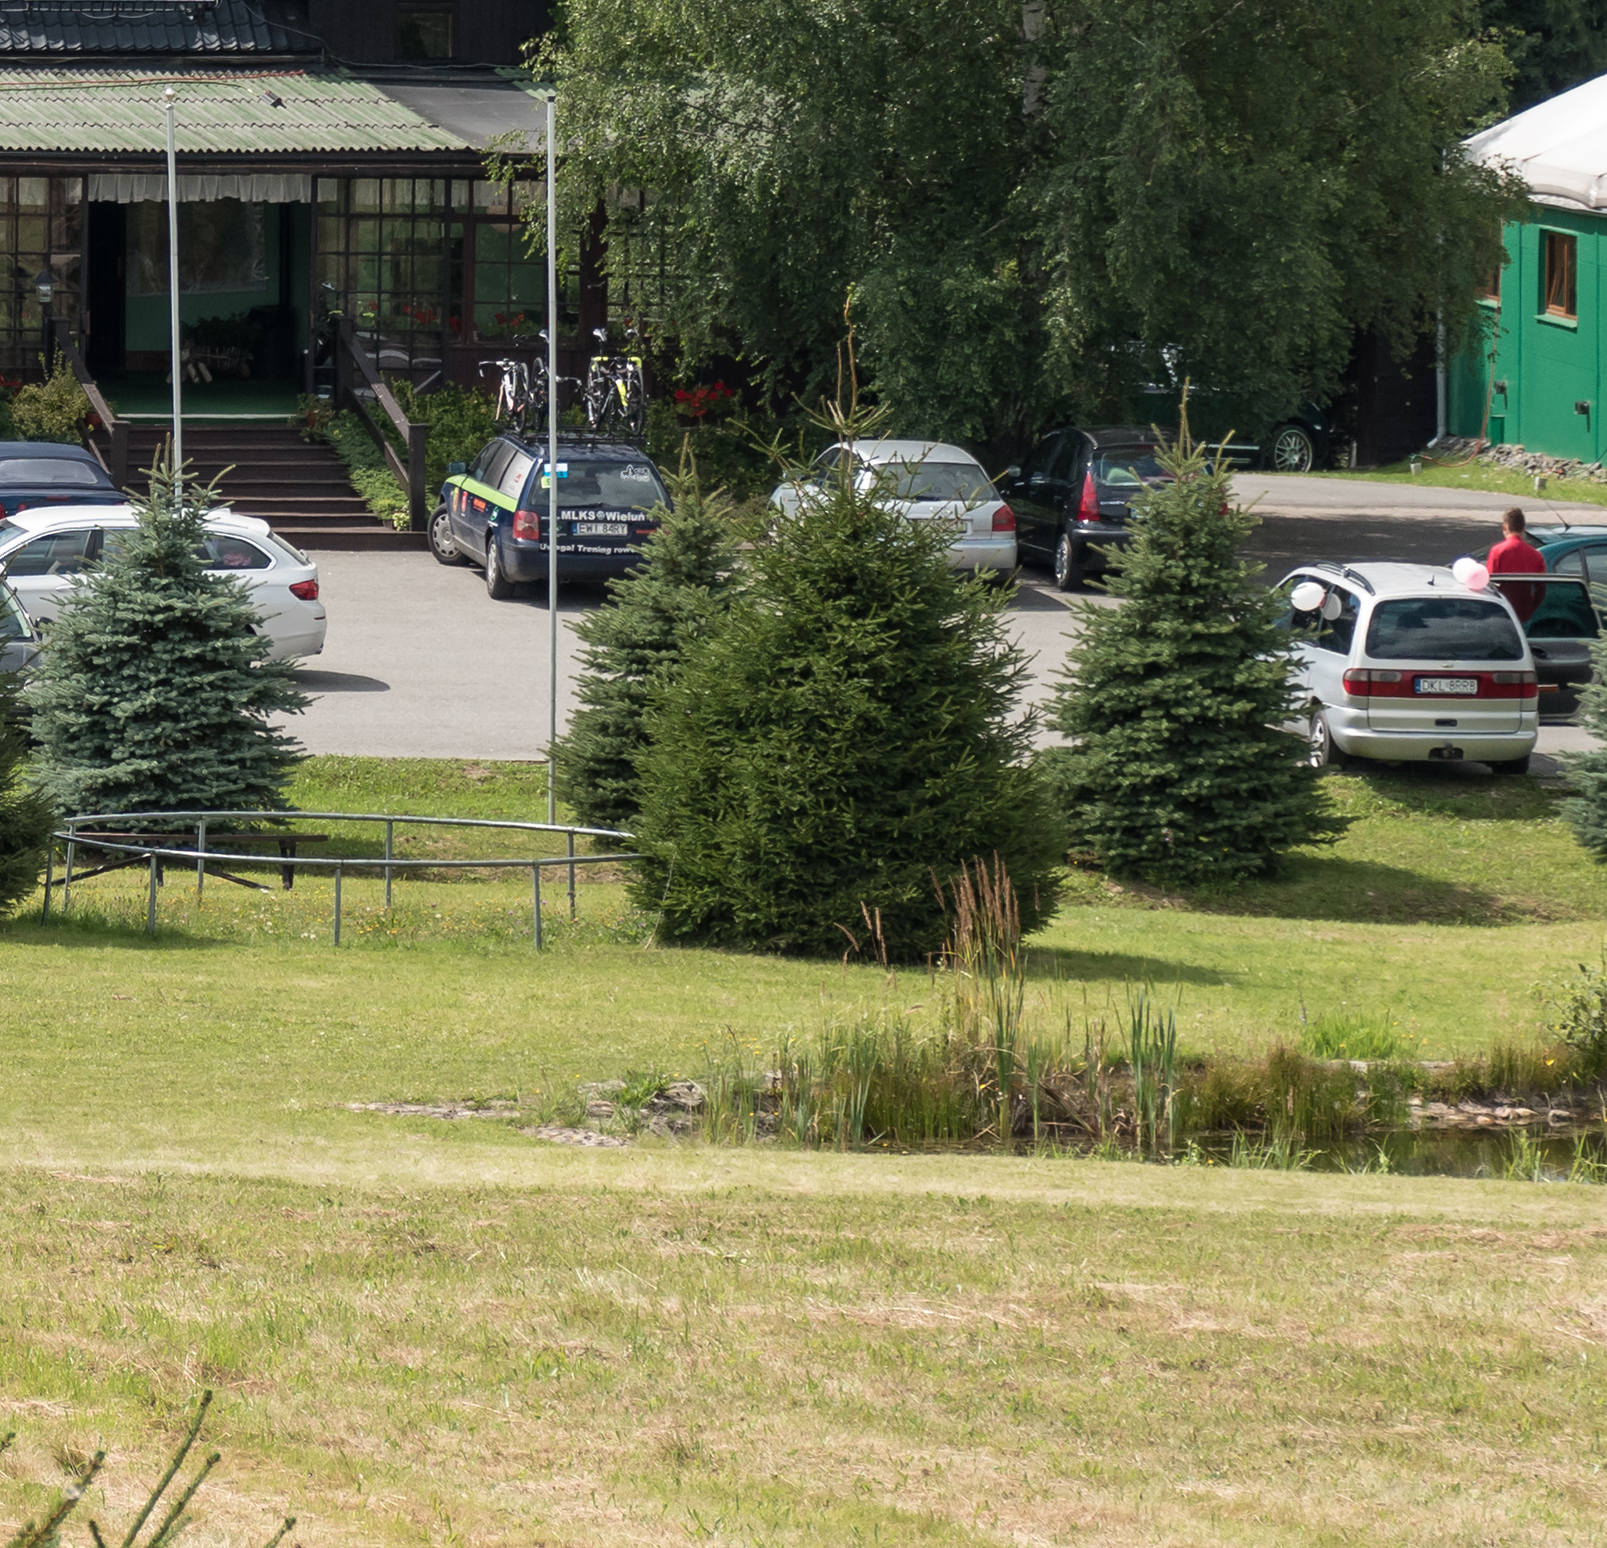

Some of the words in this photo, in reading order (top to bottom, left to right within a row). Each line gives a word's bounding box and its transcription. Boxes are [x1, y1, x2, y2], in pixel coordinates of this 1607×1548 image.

[561, 510, 596, 521] MLKS
[604, 511, 645, 522] Wieluń
[576, 544, 612, 555] Trening
[1422, 680, 1445, 691] DKL
